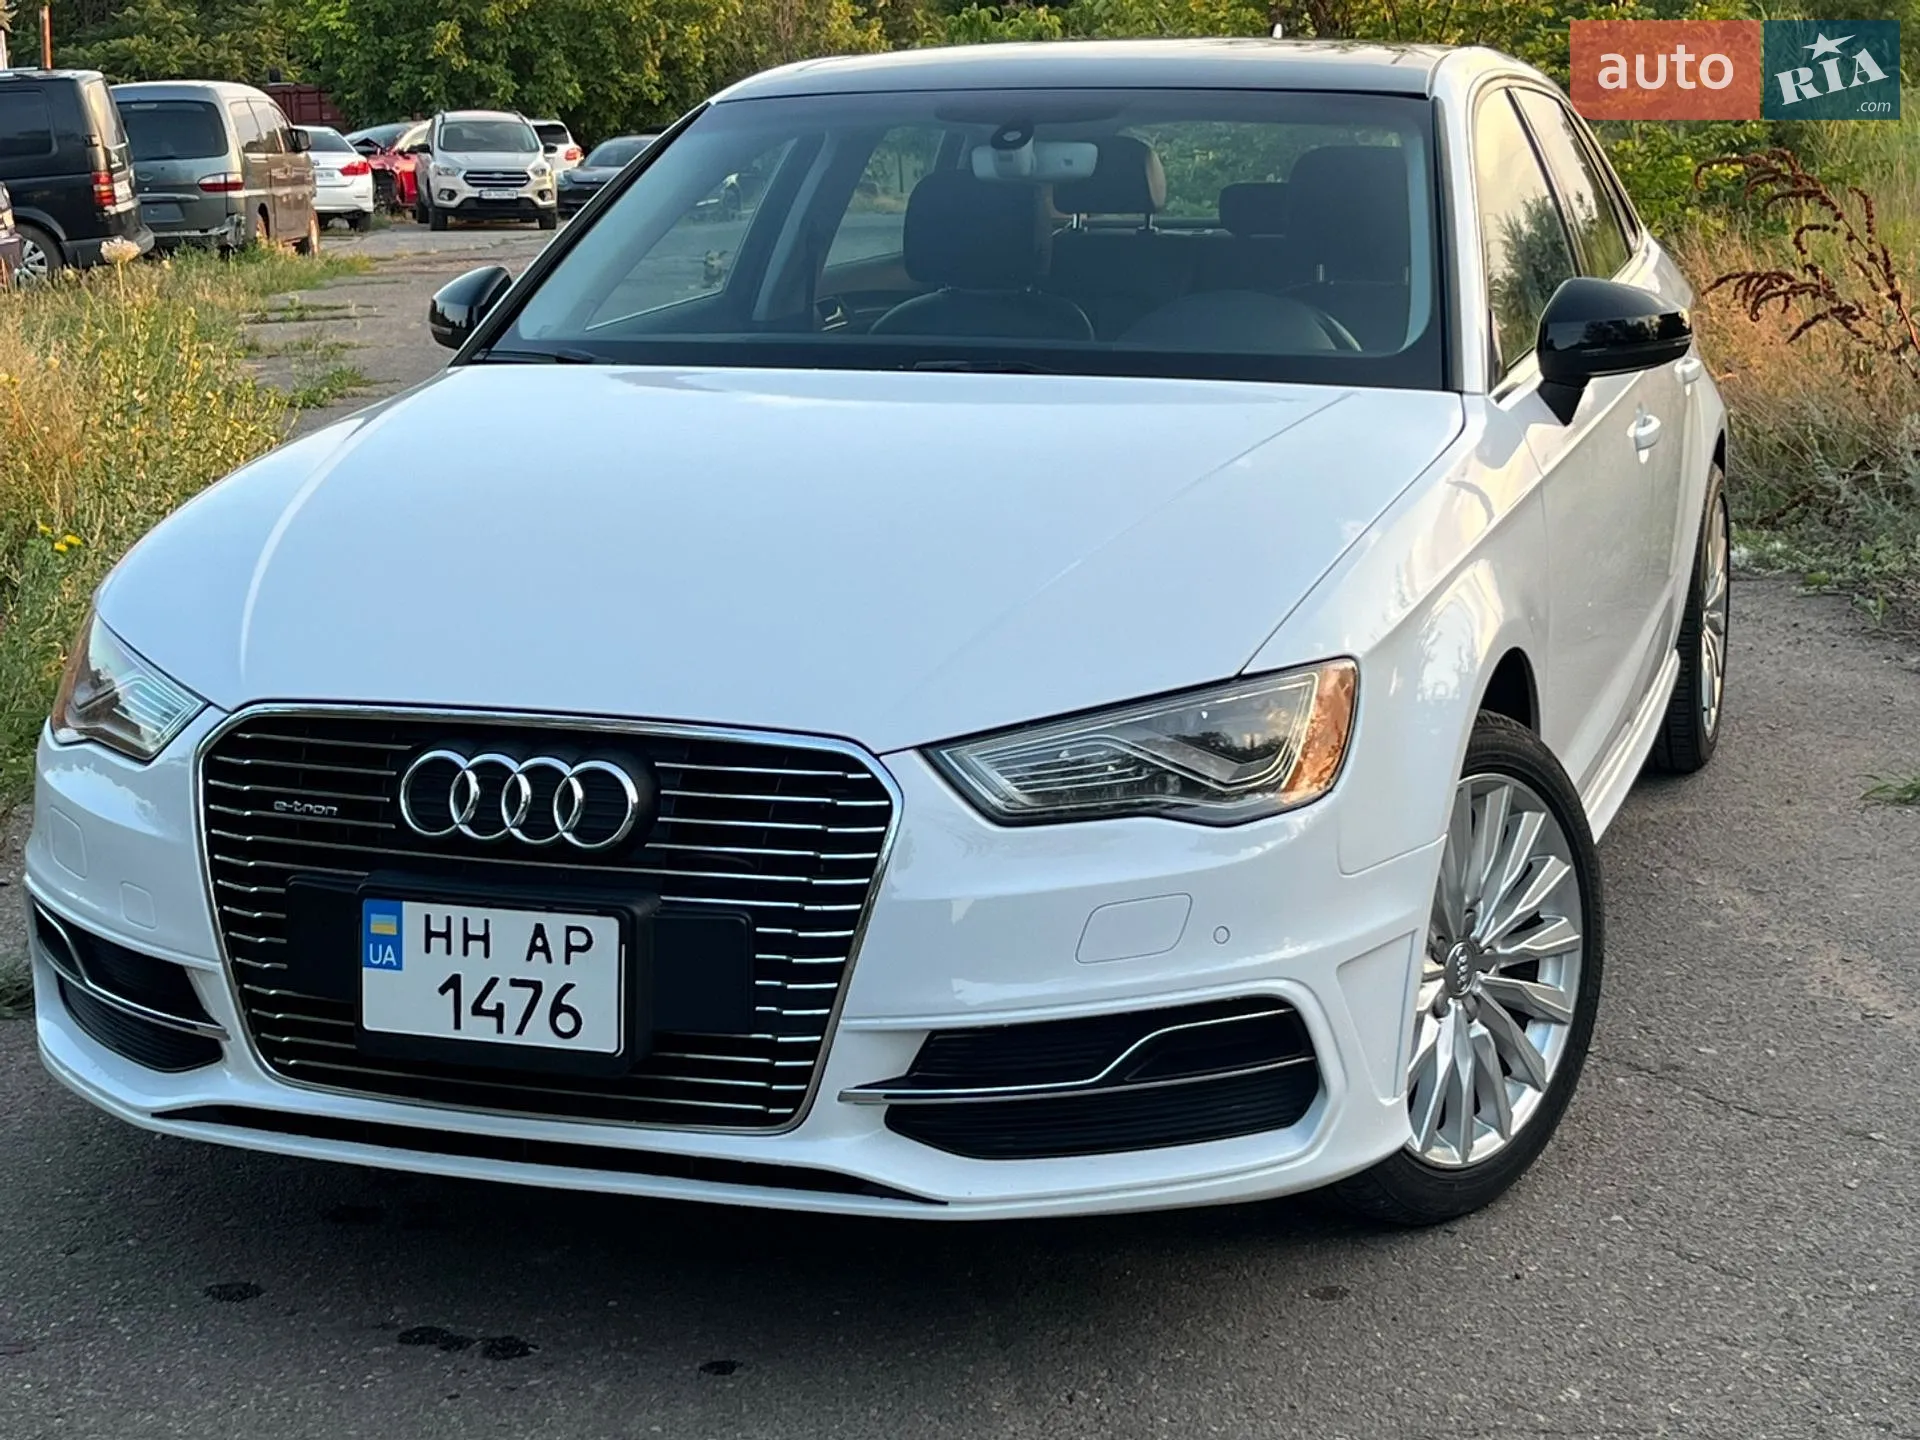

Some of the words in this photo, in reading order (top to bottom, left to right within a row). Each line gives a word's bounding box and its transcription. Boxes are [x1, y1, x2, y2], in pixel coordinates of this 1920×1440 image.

[273, 800, 338, 816] e-tron
[369, 943, 397, 966] UA
[424, 913, 490, 959] HH
[525, 922, 594, 965] AP
[437, 973, 583, 1040] 1476
